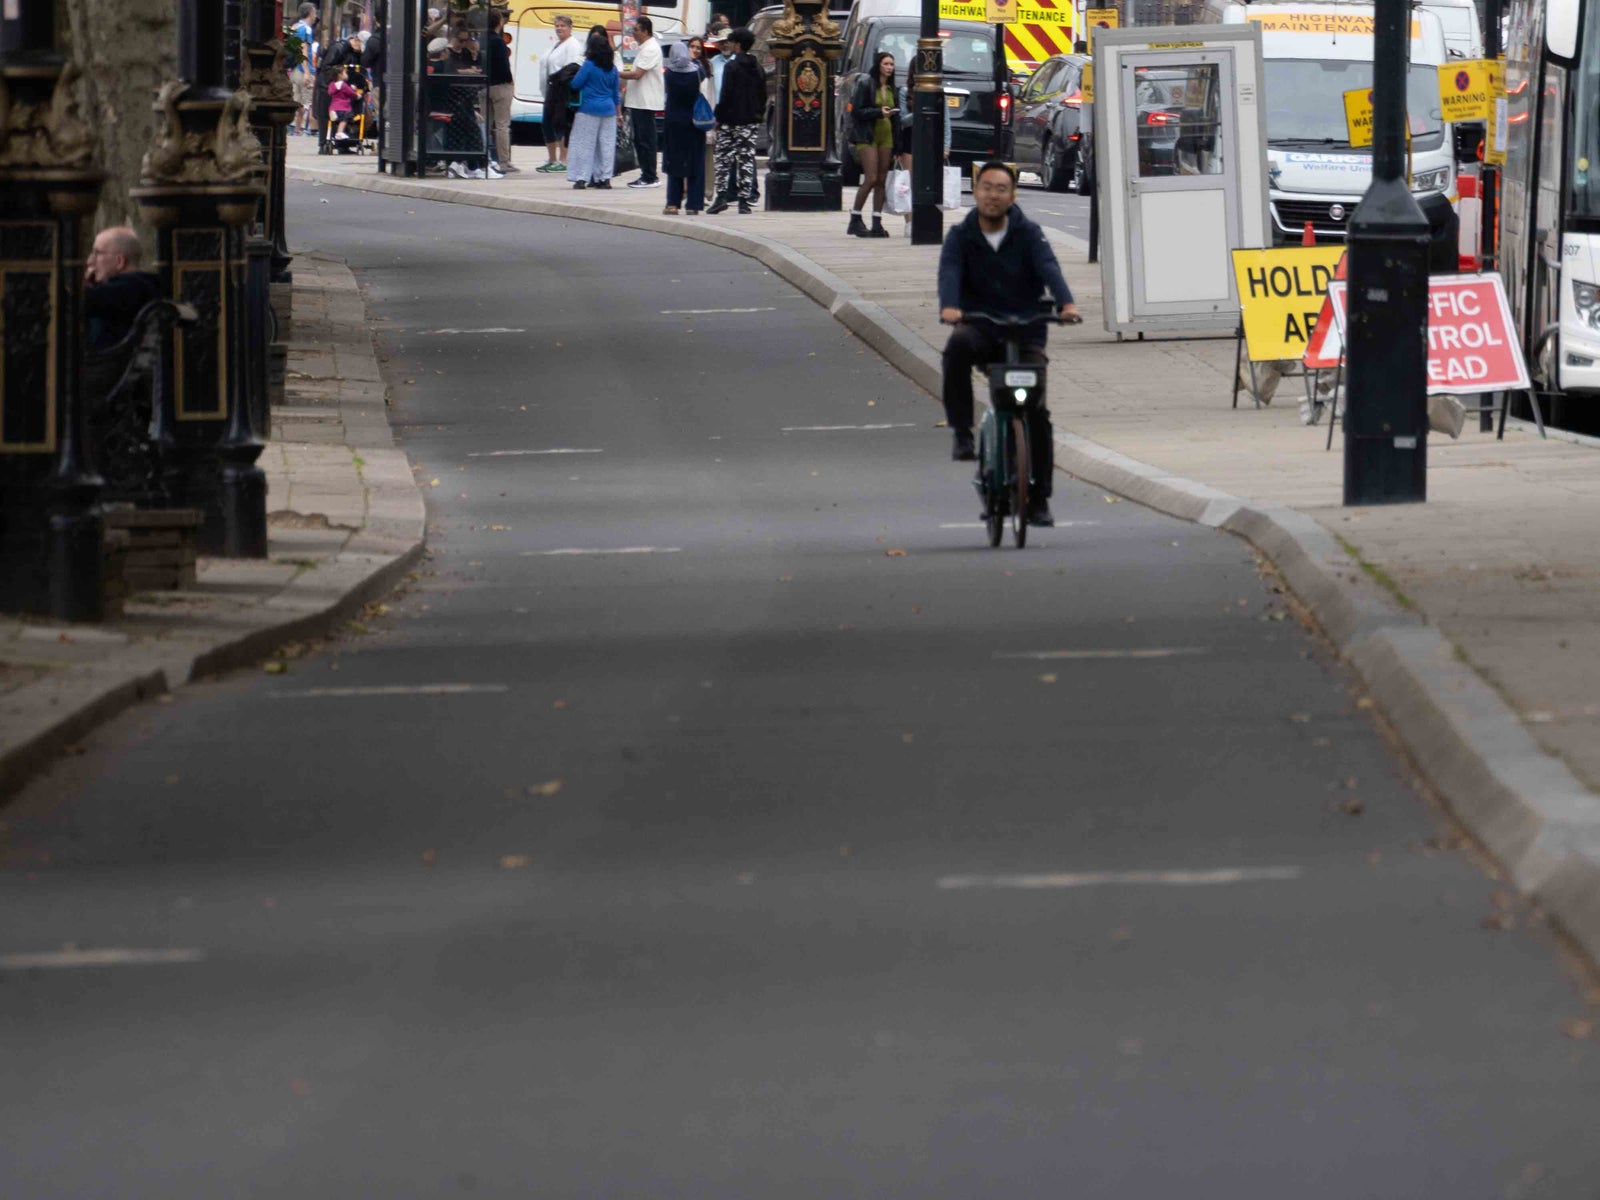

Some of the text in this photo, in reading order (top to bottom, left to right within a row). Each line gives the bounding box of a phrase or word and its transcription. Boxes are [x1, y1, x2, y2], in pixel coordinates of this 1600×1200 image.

[1018, 9, 1066, 22] TENANCE
[1442, 93, 1486, 105] WARNING
[1247, 264, 1339, 298] HOLD
[1428, 355, 1488, 381] EAD
